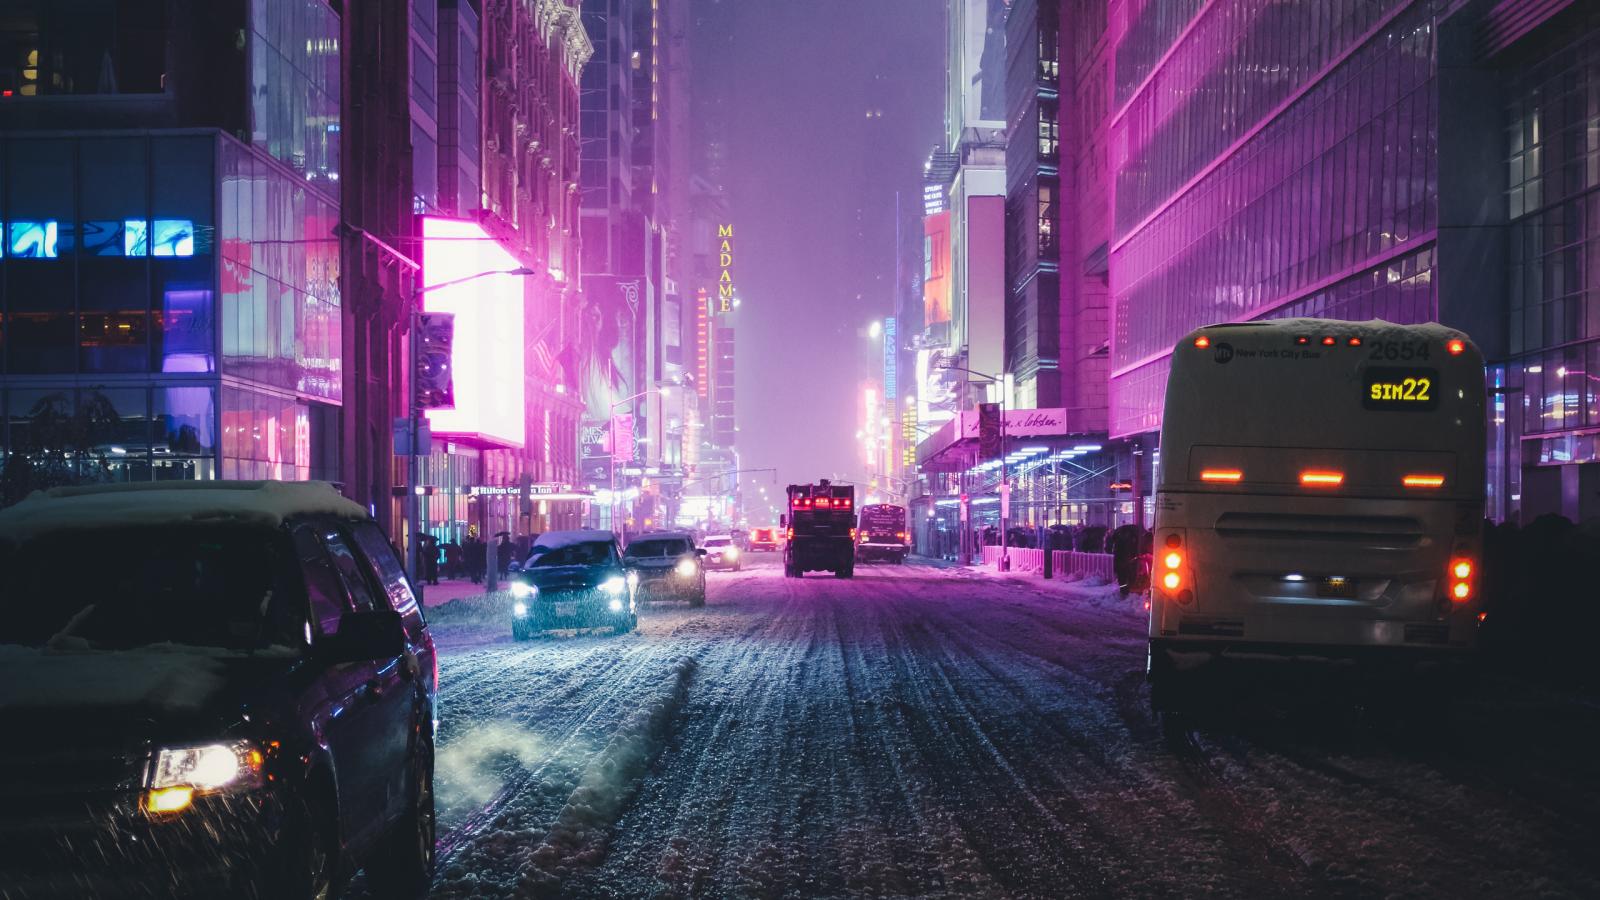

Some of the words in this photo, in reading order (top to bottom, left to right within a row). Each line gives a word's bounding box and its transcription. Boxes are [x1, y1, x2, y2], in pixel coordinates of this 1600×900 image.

[718, 224, 733, 312] MADAME
[1236, 348, 1256, 358] New
[1258, 348, 1278, 358] York
[1280, 349, 1300, 360] City
[1303, 350, 1321, 359] Bus
[1369, 341, 1430, 361] 2654
[1371, 377, 1431, 401] SIM22
[480, 486, 506, 494] Hilton
[507, 486, 536, 494] Garn
[538, 486, 552, 494] Inn
